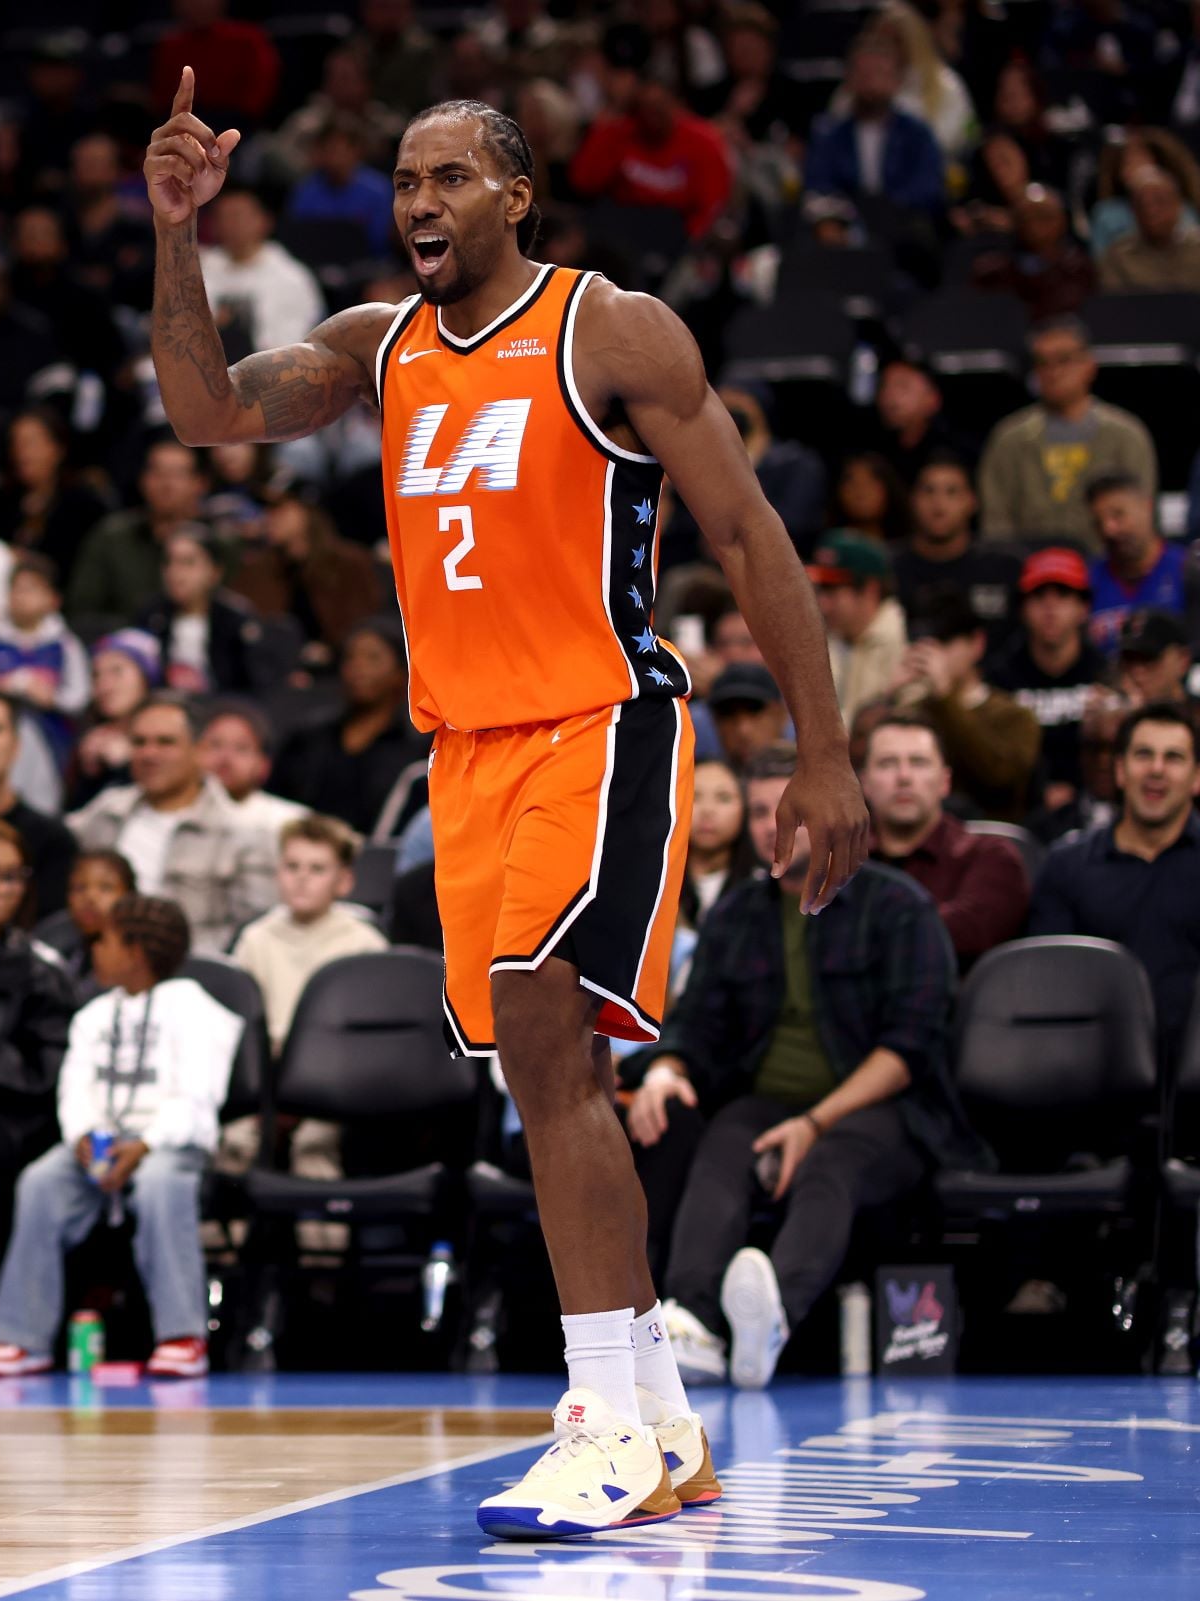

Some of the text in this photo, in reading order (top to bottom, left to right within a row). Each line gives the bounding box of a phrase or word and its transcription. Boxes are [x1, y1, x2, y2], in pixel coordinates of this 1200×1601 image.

[497, 346, 547, 358] RWANDA
[511, 338, 539, 348] VISIT
[396, 398, 532, 497] LA
[438, 505, 483, 591] 2
